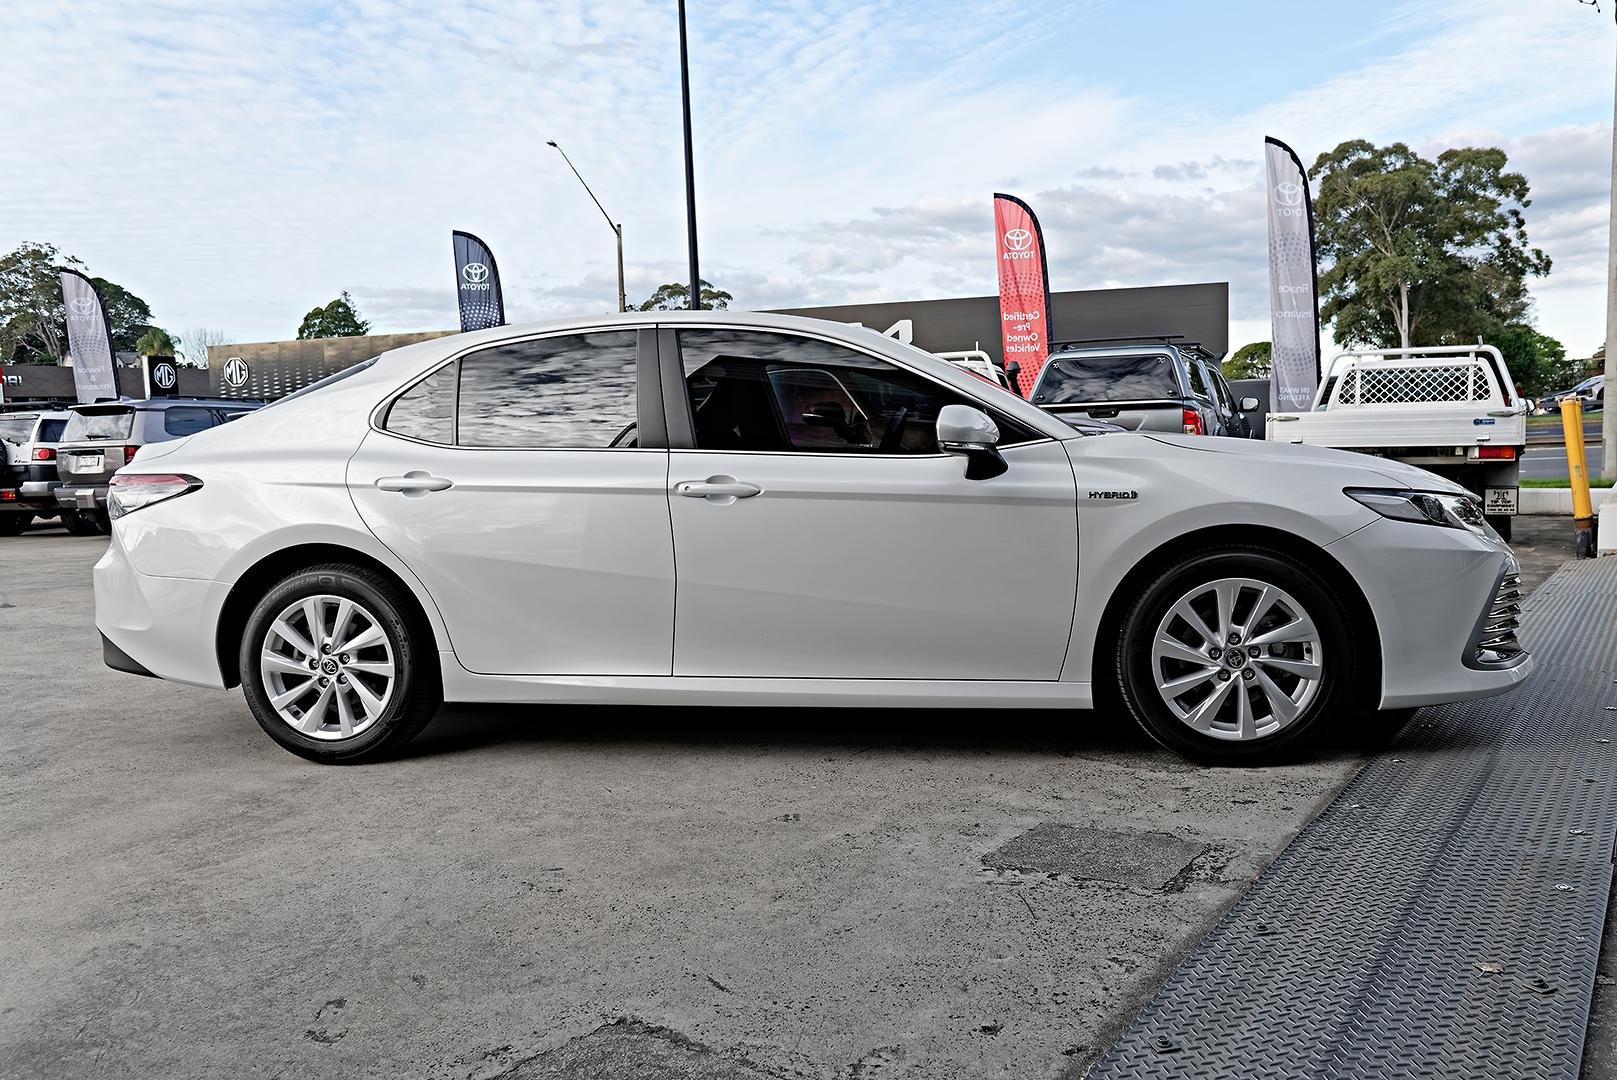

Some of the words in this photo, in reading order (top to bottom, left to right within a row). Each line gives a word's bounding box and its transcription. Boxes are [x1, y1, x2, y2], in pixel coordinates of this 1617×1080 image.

[155, 364, 175, 387] MG
[225, 359, 247, 386] MG
[1088, 491, 1130, 499] HYBRID
